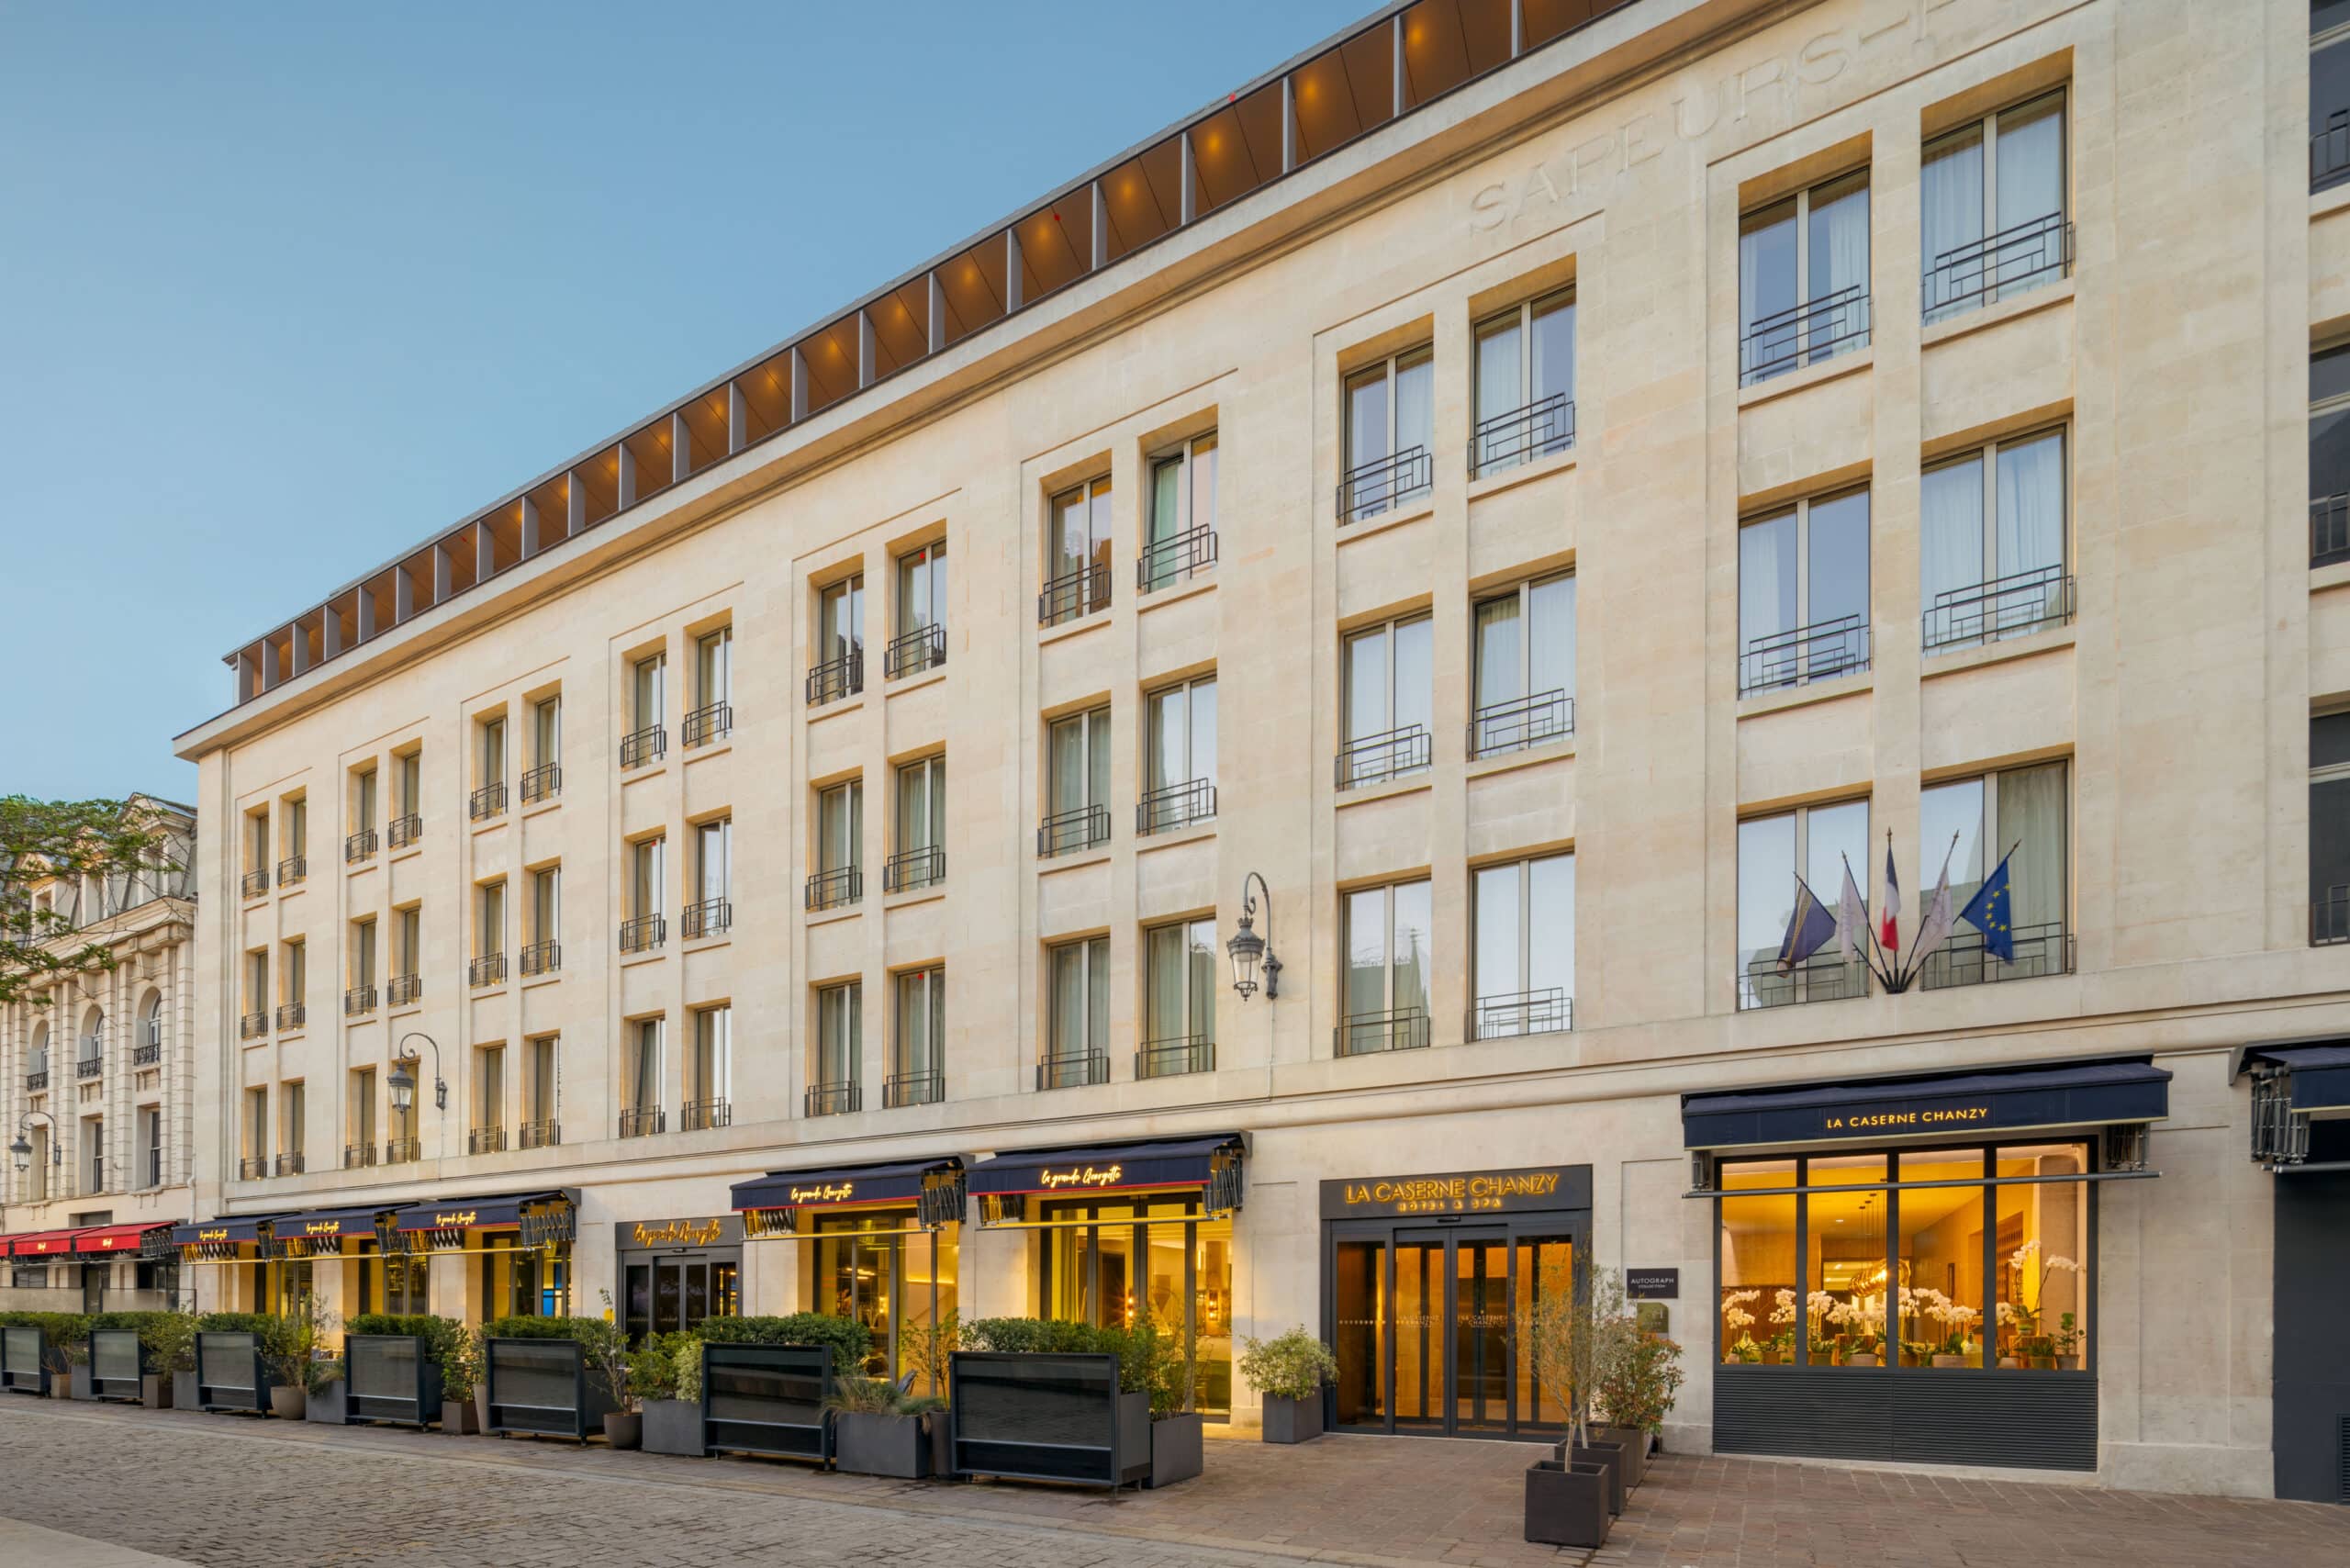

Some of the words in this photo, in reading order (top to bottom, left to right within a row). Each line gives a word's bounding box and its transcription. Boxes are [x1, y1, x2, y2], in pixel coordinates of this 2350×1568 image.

[1826, 1118, 1843, 1129] LA
[1850, 1112, 1917, 1127] CASERNE
[1922, 1108, 1988, 1122] CHANZY
[1346, 1185, 1371, 1204] LA
[1373, 1179, 1466, 1202] CASERNE
[1471, 1174, 1559, 1197] CHANZY
[1472, 1198, 1502, 1209] SPA
